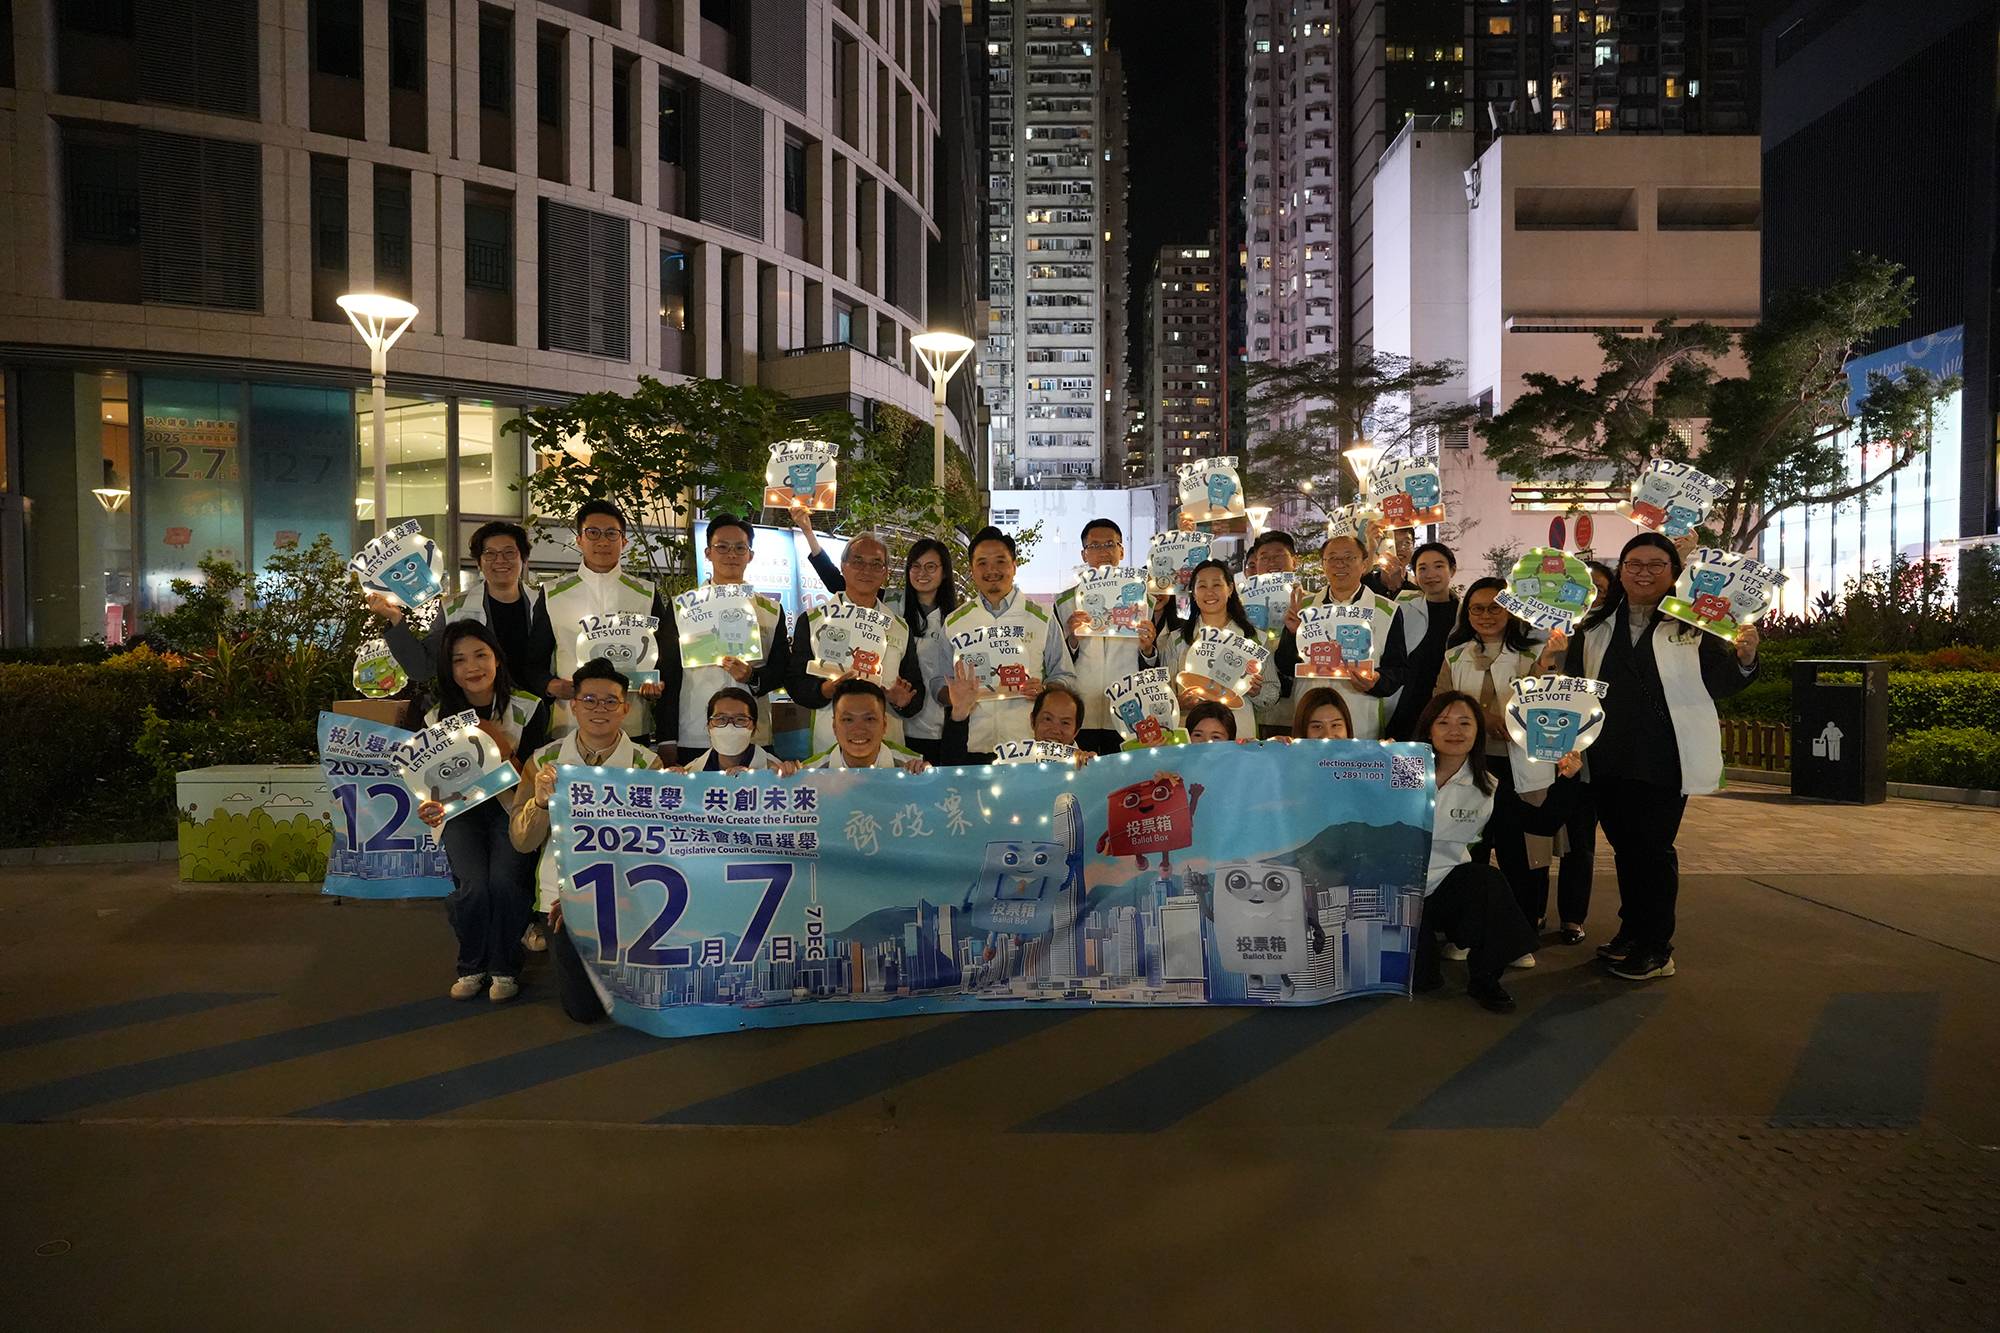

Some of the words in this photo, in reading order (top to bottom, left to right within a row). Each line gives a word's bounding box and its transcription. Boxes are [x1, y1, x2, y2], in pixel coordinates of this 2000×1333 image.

[144, 432, 180, 443] 2025
[776, 454, 794, 464] LET'S
[795, 453, 814, 461] VOTE
[1652, 459, 1690, 478] 12.7
[1181, 475, 1199, 488] LET'S
[1184, 481, 1201, 492] VOTE
[1374, 484, 1393, 496] VOTE
[1681, 481, 1702, 496] LET'S
[1327, 504, 1356, 524] 12.7
[1333, 526, 1351, 537] VOTE
[1156, 546, 1171, 554] LET'S
[365, 558, 383, 578] LET'S
[382, 544, 402, 561] VOTE
[1086, 581, 1102, 591] LET'S
[1101, 580, 1118, 588] VOTE
[1740, 573, 1764, 589] LET'S
[1248, 587, 1266, 598] LET'S
[1265, 585, 1284, 593] VOTE
[1527, 597, 1550, 612] VOTE
[682, 605, 703, 620] LET'S
[691, 610, 714, 623] VOTE
[821, 604, 855, 619] 12.7
[1299, 605, 1333, 624] 12.7
[1550, 607, 1573, 619] LET'S
[855, 621, 874, 633] LET'S
[1533, 613, 1573, 635] 12.7
[587, 630, 609, 641] LET'S
[609, 628, 631, 637] VOTE
[862, 631, 882, 644] VOTE
[952, 627, 984, 650] 12.7
[1302, 630, 1323, 640] VOTE
[989, 640, 1010, 648] LET'S
[1197, 642, 1216, 650] ET'S
[999, 647, 1020, 655] VOTE
[1195, 649, 1216, 658] VOTE
[1106, 675, 1132, 701] 12.7
[1141, 685, 1160, 695] LET'S
[1512, 676, 1556, 696] 12.7
[1149, 692, 1169, 702] VOTE
[1519, 693, 1544, 704] LET'S
[1545, 692, 1572, 702] VOTE
[326, 745, 339, 754] Join
[340, 747, 350, 756] the
[351, 748, 379, 759] Election
[392, 731, 430, 769] 12.7
[409, 752, 433, 773] LET'S
[430, 737, 455, 756] VOTE
[995, 740, 1034, 760] 12.7
[325, 758, 390, 777] 2025
[1318, 759, 1385, 769] elections.gov.hk
[1342, 771, 1362, 779] 2891
[1365, 772, 1384, 780] 1001
[571, 784, 683, 811] 投入選舉
[704, 787, 817, 812] 共創未來
[571, 809, 594, 818] Join
[596, 808, 615, 818] the
[617, 809, 658, 820] Election
[659, 812, 706, 826] Together
[707, 815, 725, 825] We
[726, 815, 761, 825] Create
[763, 814, 780, 824] the
[783, 814, 817, 824] Future
[1126, 814, 1172, 838] 投票箱
[573, 824, 666, 854] 2025
[1131, 836, 1153, 846] Ballot
[1154, 833, 1169, 843] Box
[670, 846, 716, 856] Legislative
[717, 845, 749, 855] Council
[750, 847, 783, 856] General
[784, 849, 819, 858] Election
[572, 863, 793, 966] 12月7日
[806, 907, 822, 918] 7
[990, 902, 1036, 918] 投票箱
[992, 916, 1013, 924] Ballot
[1015, 917, 1029, 925] Box
[806, 923, 823, 960] DEC
[1236, 936, 1287, 952] 投票箱
